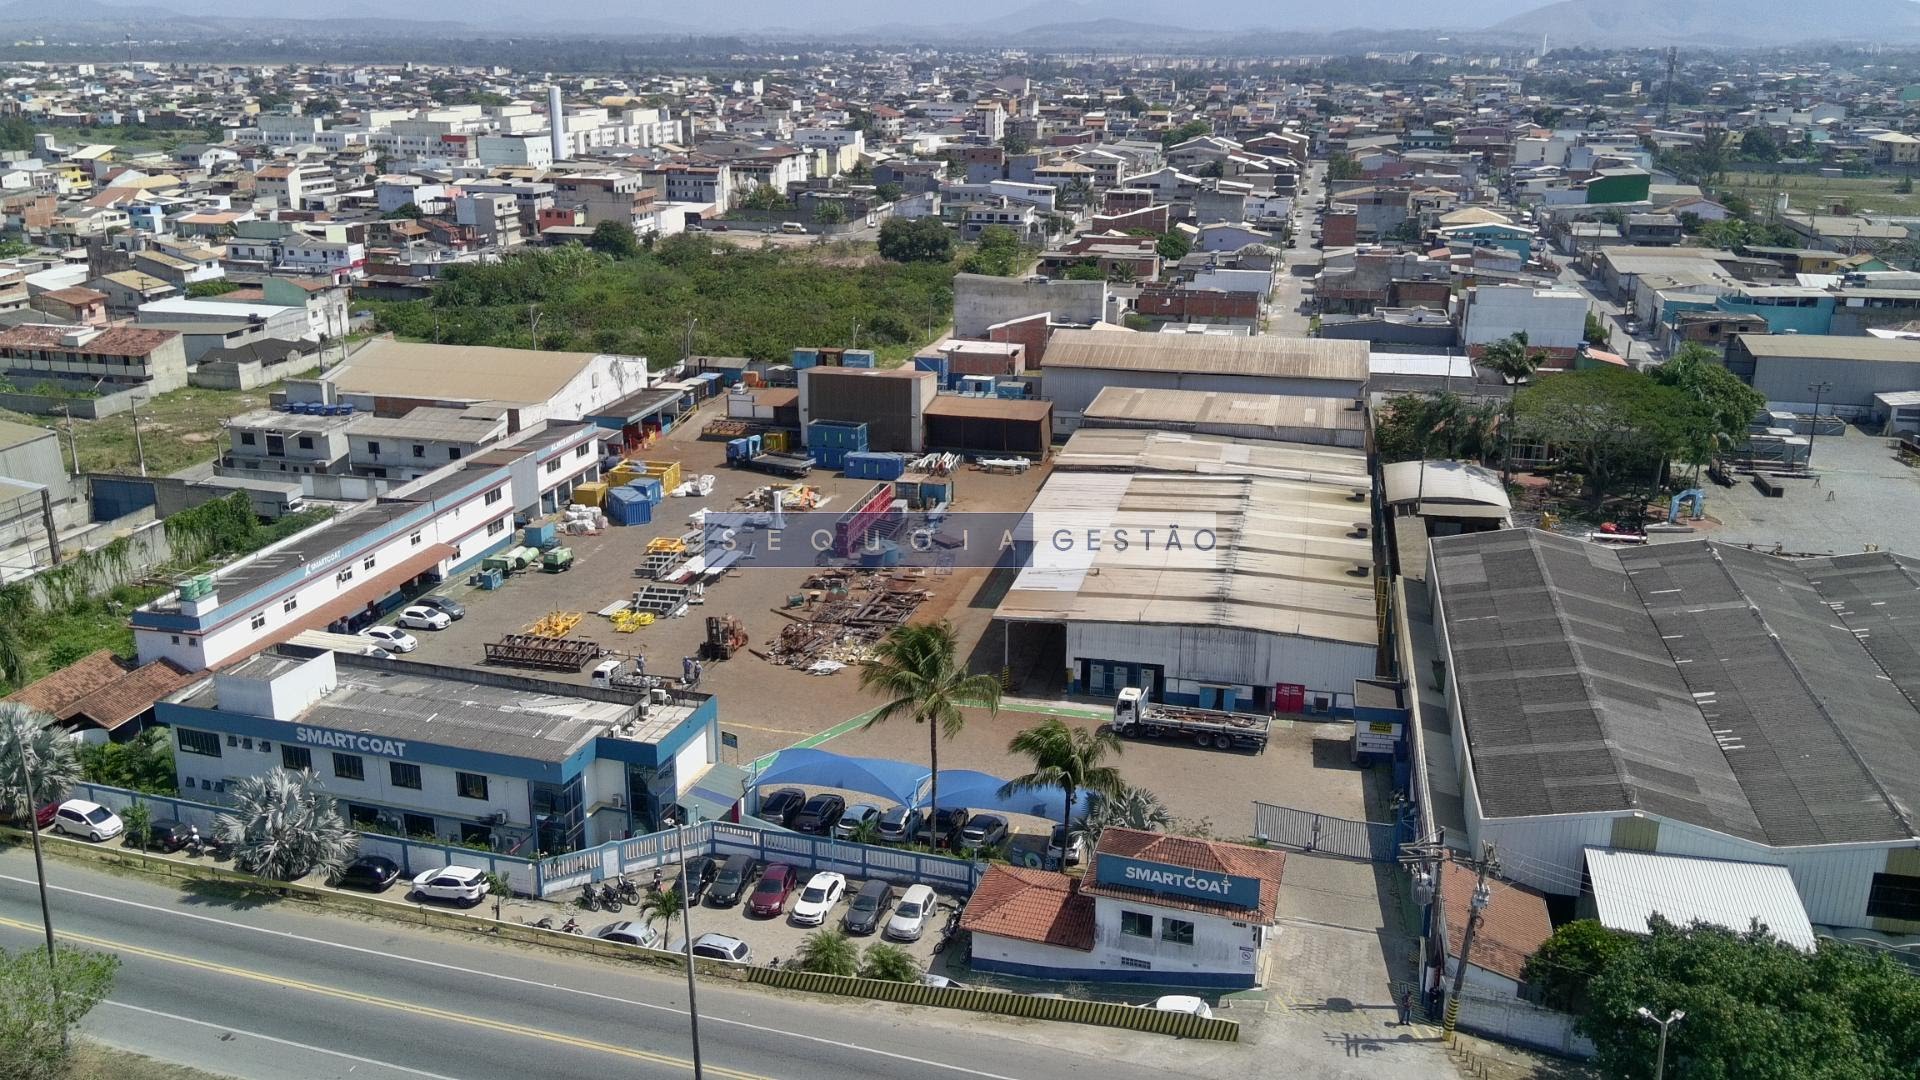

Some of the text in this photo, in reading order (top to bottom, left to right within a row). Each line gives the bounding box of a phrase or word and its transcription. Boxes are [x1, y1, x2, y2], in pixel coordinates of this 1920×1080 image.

[310, 549, 342, 571] SMARTCOAT
[296, 726, 406, 757] SMARTCOAT
[1125, 866, 1232, 895] SMARTCOAT
